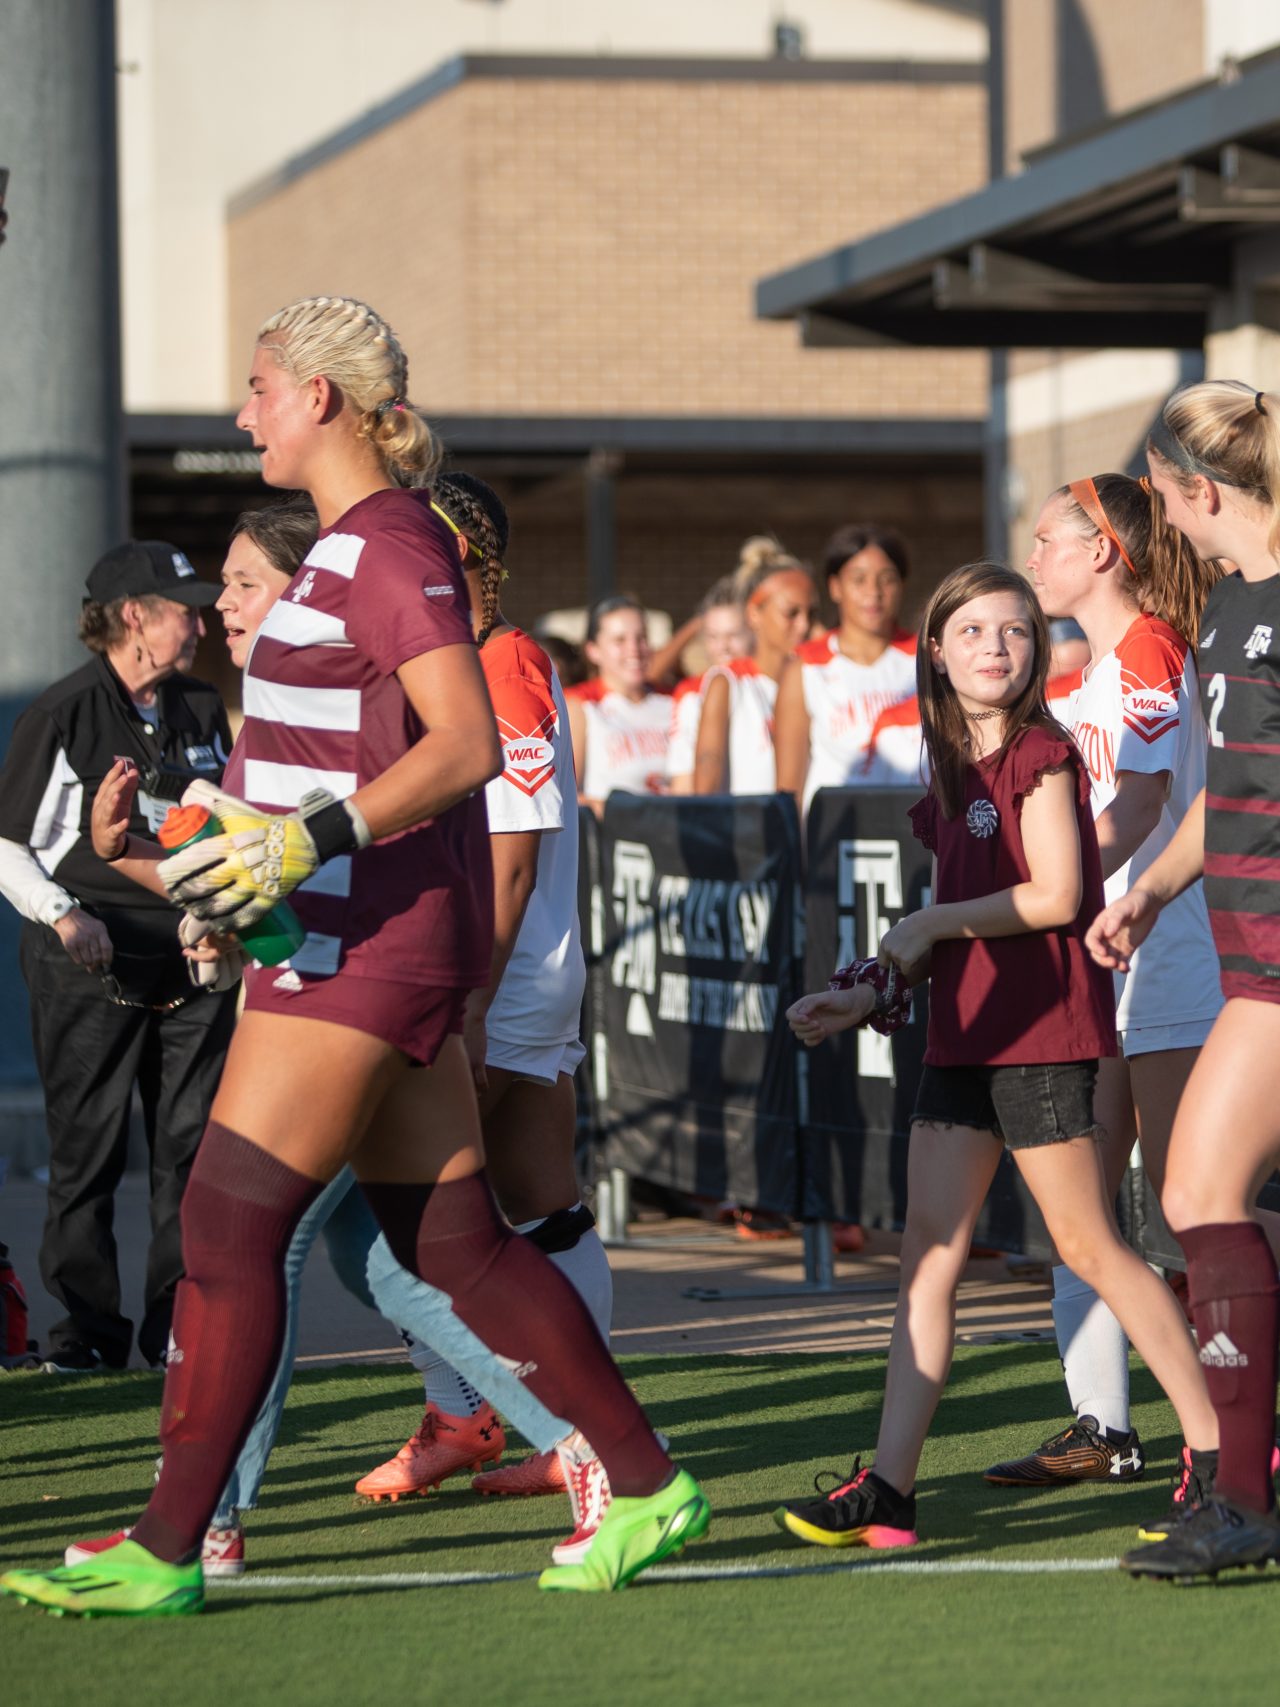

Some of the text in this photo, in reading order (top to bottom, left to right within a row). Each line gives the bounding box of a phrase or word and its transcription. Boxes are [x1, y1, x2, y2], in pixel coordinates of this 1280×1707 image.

[1132, 697, 1170, 712] WAC
[506, 746, 545, 761] WAC
[262, 819, 286, 896] adidas
